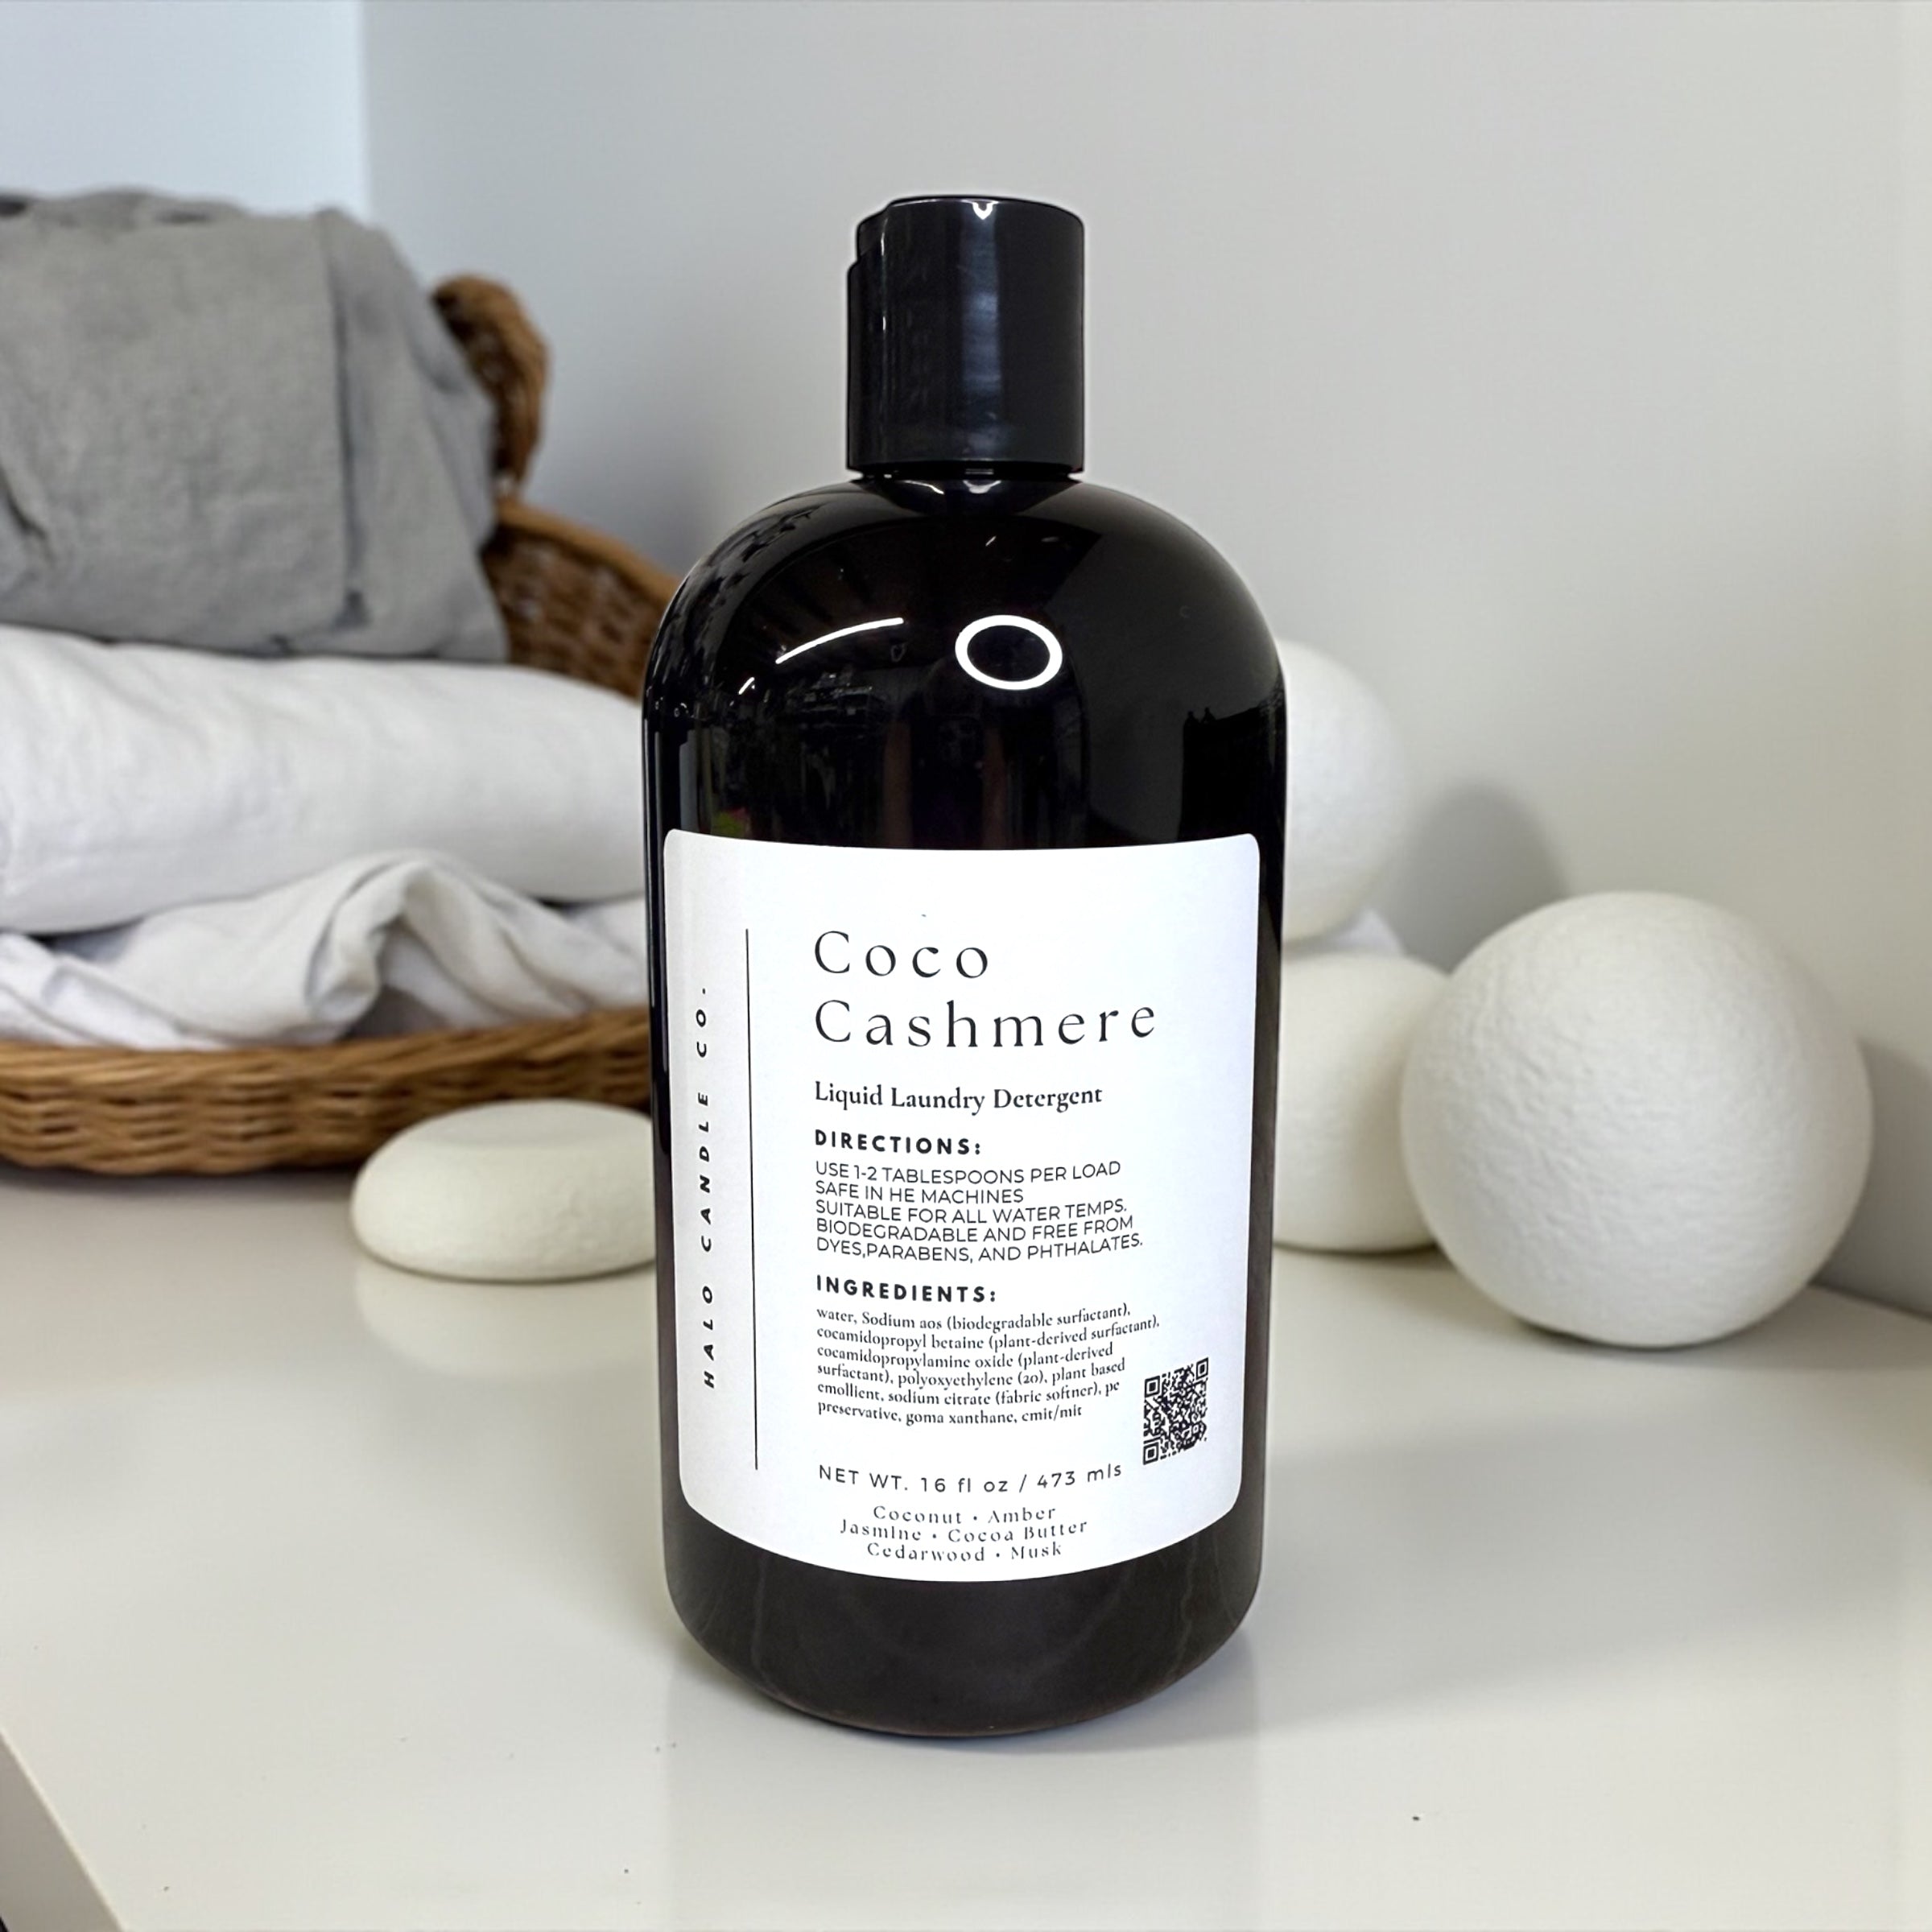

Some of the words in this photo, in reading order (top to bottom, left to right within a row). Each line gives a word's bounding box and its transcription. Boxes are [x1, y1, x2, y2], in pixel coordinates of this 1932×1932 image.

[814, 931, 989, 978] Coco
[695, 988, 708, 1058] CO.
[815, 1000, 1155, 1047] Cashmere
[815, 1081, 883, 1110] Liquid
[890, 1087, 985, 1116] Laundry
[993, 1088, 1103, 1113] Detergent
[815, 1129, 981, 1154] DIRECTIONS:
[697, 1092, 712, 1252] CANDLE
[815, 1161, 849, 1177] USE
[852, 1165, 877, 1181] 1-2
[881, 1167, 1025, 1184] TABLESPOONS
[1030, 1166, 1067, 1182] PER
[1071, 1161, 1122, 1179] LOAD
[815, 1181, 859, 1199] SAFE
[865, 1186, 883, 1200] IN
[890, 1188, 914, 1203] HE
[921, 1188, 1024, 1204] MACHINES
[815, 1199, 902, 1221] SUITABLE
[907, 1208, 947, 1223] FOR
[951, 1208, 987, 1224] ALL
[992, 1206, 1061, 1223] WATER
[1064, 1199, 1128, 1219] TEMPS.
[816, 1219, 978, 1243] BIODEGRADABLE
[982, 1227, 1026, 1242] AND
[1032, 1223, 1078, 1240] FREE
[1083, 1216, 1133, 1236] FROM
[977, 1246, 1022, 1261] AND
[1027, 1233, 1143, 1259] PHTHALATES.
[816, 1274, 997, 1302] INGREDIENTS:
[861, 1311, 915, 1328] Sodium
[919, 1319, 942, 1329] aos
[947, 1313, 1053, 1333] (biodegradable
[1056, 1302, 1131, 1325] surfactant),
[701, 1286, 716, 1389] HALO
[816, 1327, 927, 1352] cocamidopropyl
[931, 1334, 985, 1348] betaine
[989, 1327, 1088, 1352] (plant-derived
[816, 1347, 971, 1371] cocamidopropylamine
[974, 1353, 1013, 1368] oxide
[1018, 1341, 1113, 1370] (plant-derived
[898, 1370, 1013, 1390] polyoxyethylene
[1051, 1367, 1087, 1386] plant
[1091, 1357, 1125, 1377] based
[888, 1389, 939, 1404] sodium
[943, 1393, 991, 1405] citrate
[995, 1389, 1042, 1405] (fabric
[1104, 1381, 1120, 1397] pe
[906, 1413, 944, 1426] goma
[819, 1464, 860, 1484] NET
[869, 1473, 909, 1490] WT.
[920, 1477, 946, 1493] 16
[957, 1477, 972, 1492] fl
[984, 1479, 1009, 1492] oz
[1018, 1475, 1027, 1492] /
[1036, 1471, 1076, 1488] 473
[1087, 1463, 1122, 1482] mls
[873, 1505, 962, 1524] Coconut
[988, 1507, 1056, 1523] Amber
[840, 1519, 922, 1541] Jasmine
[947, 1529, 1013, 1542] Cocoa
[1024, 1521, 1088, 1539] Butter
[867, 1542, 985, 1562] Cedarwood
[1011, 1542, 1062, 1559] Musk
